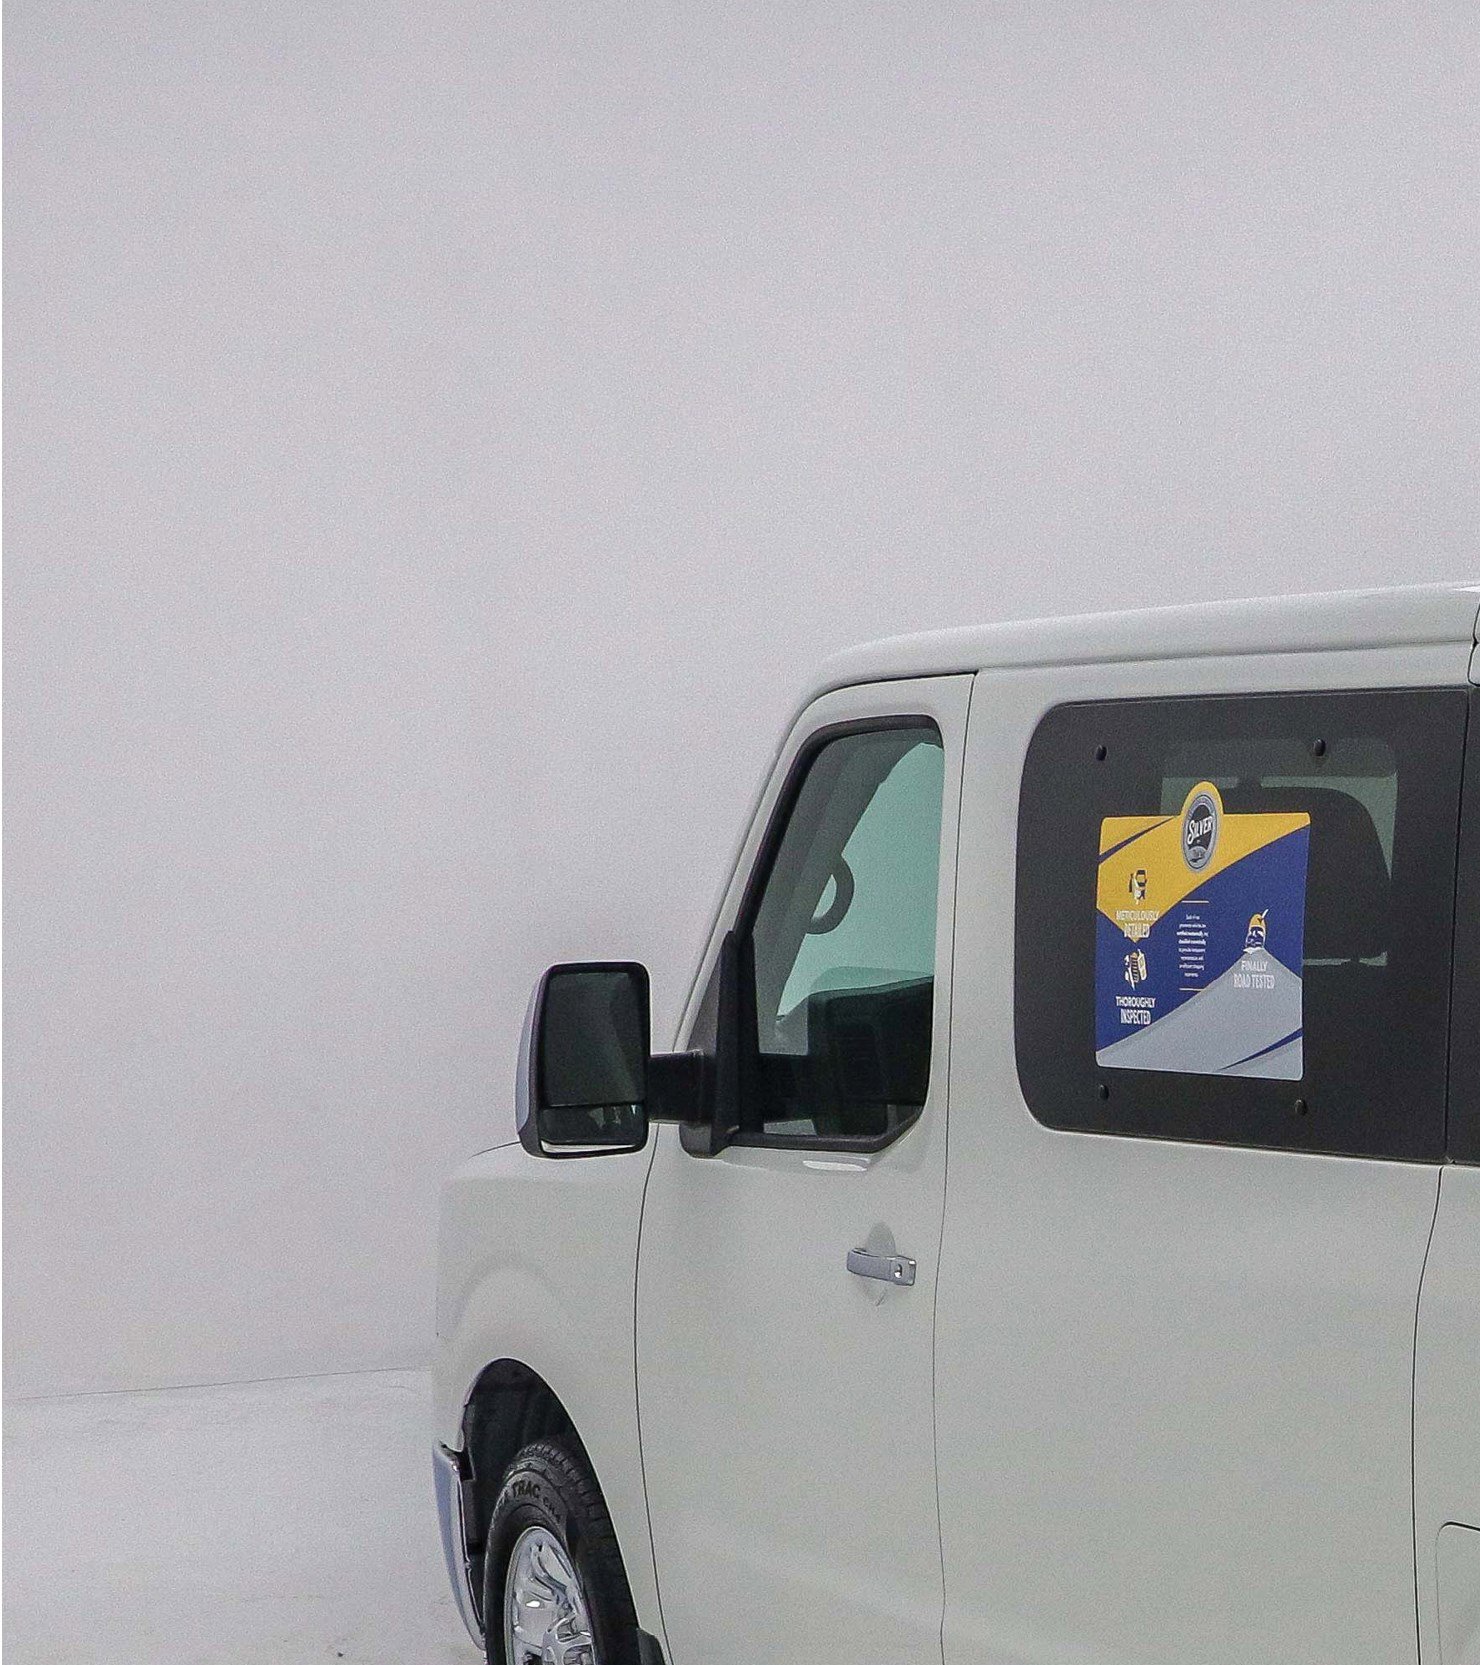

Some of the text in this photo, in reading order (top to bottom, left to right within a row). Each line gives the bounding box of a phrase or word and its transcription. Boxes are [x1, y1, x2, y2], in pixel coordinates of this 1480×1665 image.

[1187, 815, 1213, 845] SILVER
[1241, 960, 1268, 972] FINALLY
[1233, 974, 1275, 990] ROAD TESTED
[1115, 996, 1156, 1009] THOROUGHLY
[1120, 1009, 1151, 1025] INSPECTED
